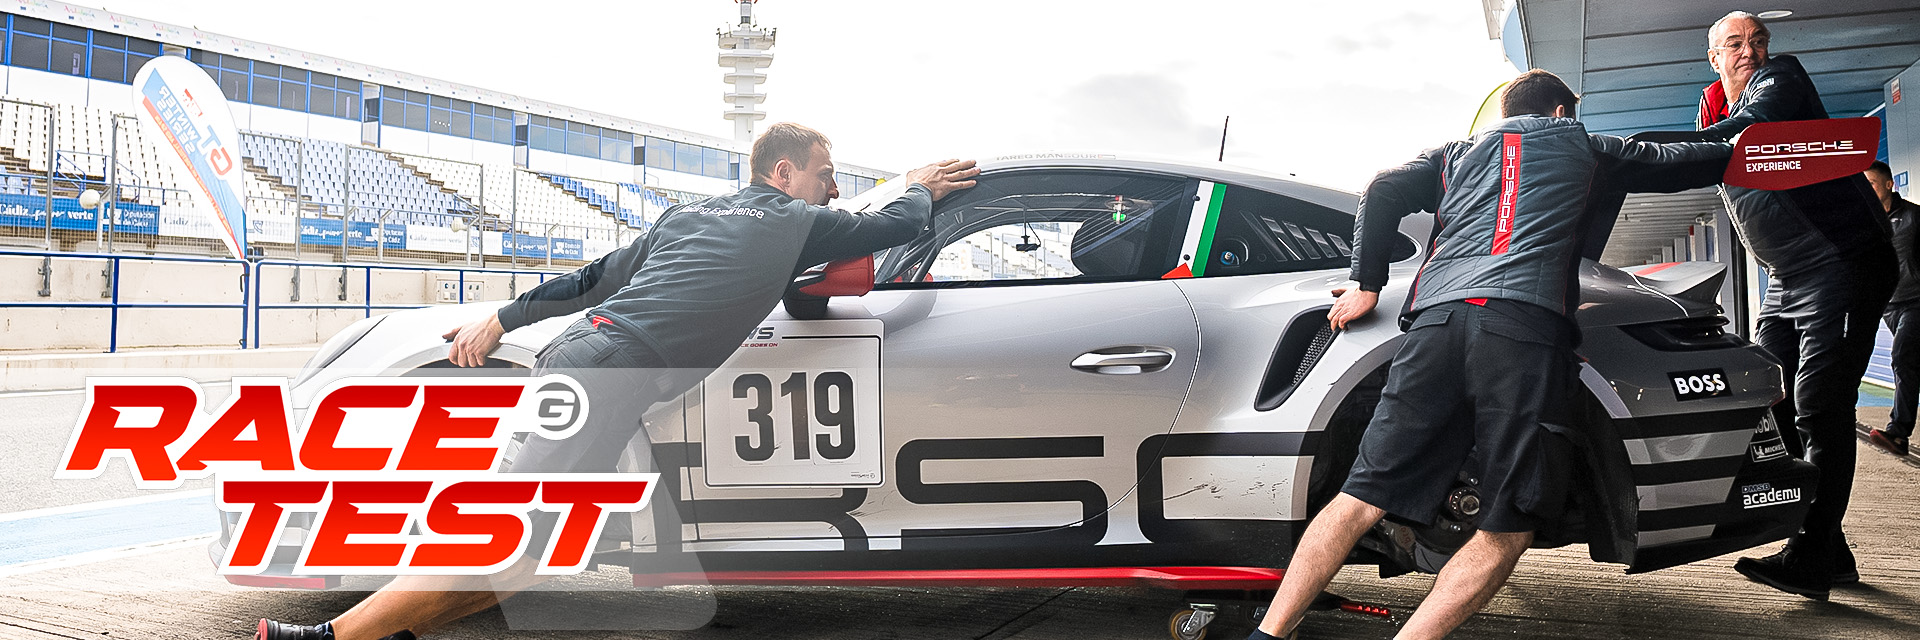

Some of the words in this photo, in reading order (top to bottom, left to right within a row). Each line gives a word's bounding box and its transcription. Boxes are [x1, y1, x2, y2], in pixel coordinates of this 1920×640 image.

[1745, 140, 1854, 155] PORSCHE
[1746, 161, 1801, 172] EXPERIENCE
[1499, 146, 1516, 232] PORSCHE
[1674, 373, 1726, 394] BOSS
[733, 371, 856, 461] 319
[1742, 483, 1771, 493] DMSB
[1743, 488, 1800, 506] academy
